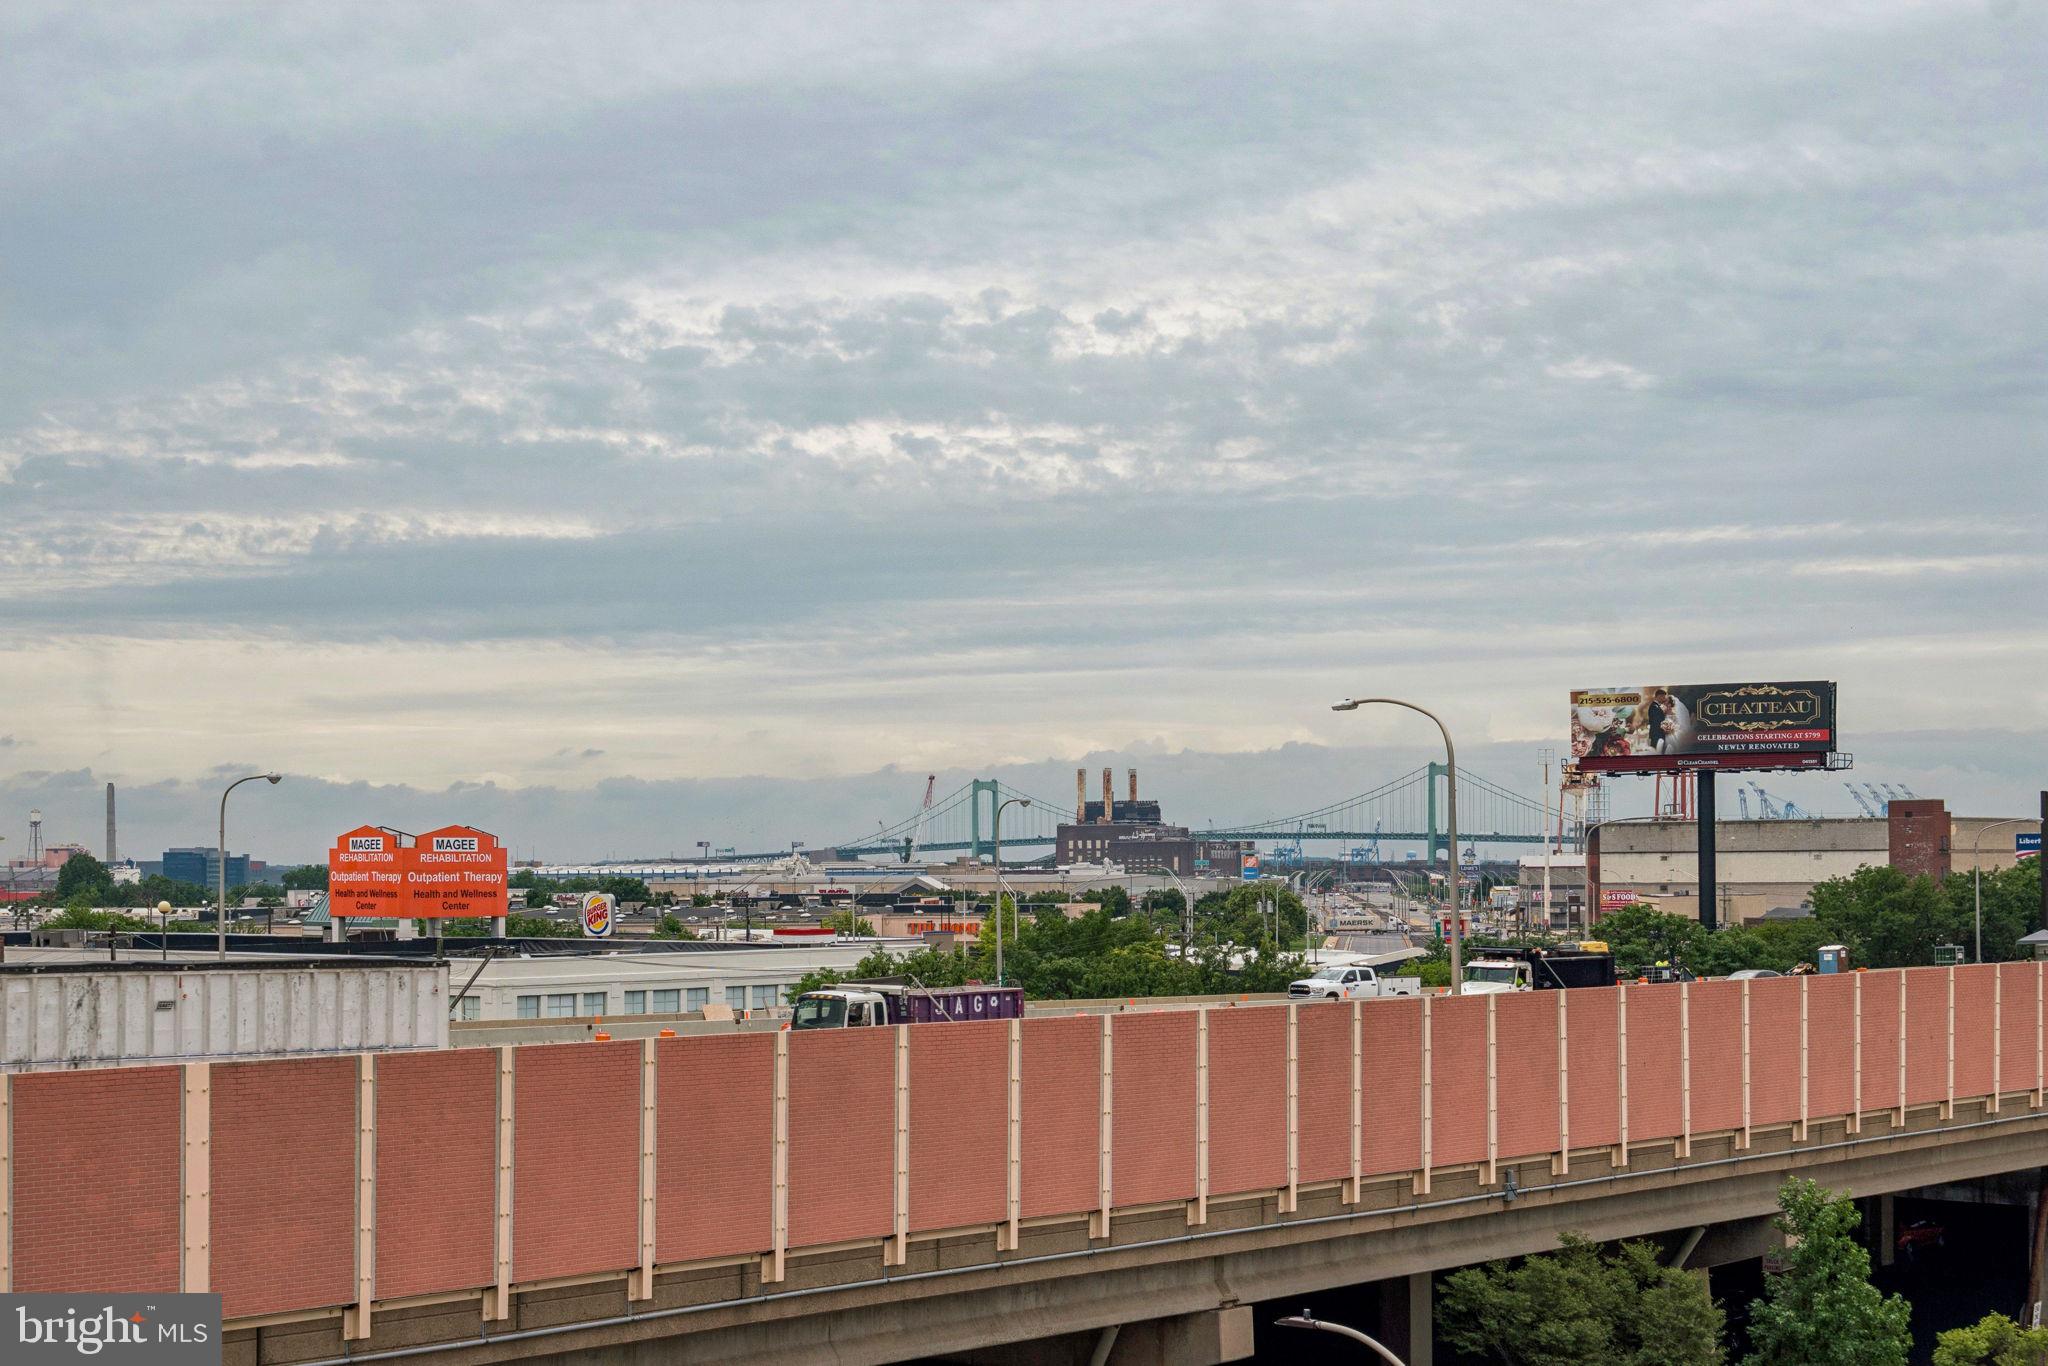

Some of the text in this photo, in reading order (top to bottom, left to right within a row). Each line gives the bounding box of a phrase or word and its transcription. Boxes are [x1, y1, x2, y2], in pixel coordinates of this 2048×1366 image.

[1580, 695, 1639, 705] 215-535-6800
[1706, 700, 1812, 716] CHATEAU
[351, 839, 381, 850] MAGEE
[436, 839, 476, 850] MAGEE
[340, 853, 394, 862] REHABILITATION
[420, 853, 492, 863] REHABILITATION
[331, 871, 402, 884] Outpatient Therapy
[408, 871, 503, 884] Outpatient Therapy
[335, 889, 398, 898] Health and Wellness
[413, 889, 498, 899] Health and Wellness
[355, 901, 377, 910] Center
[442, 901, 470, 910] Center
[587, 902, 607, 917] BURGER
[587, 910, 608, 926] KING
